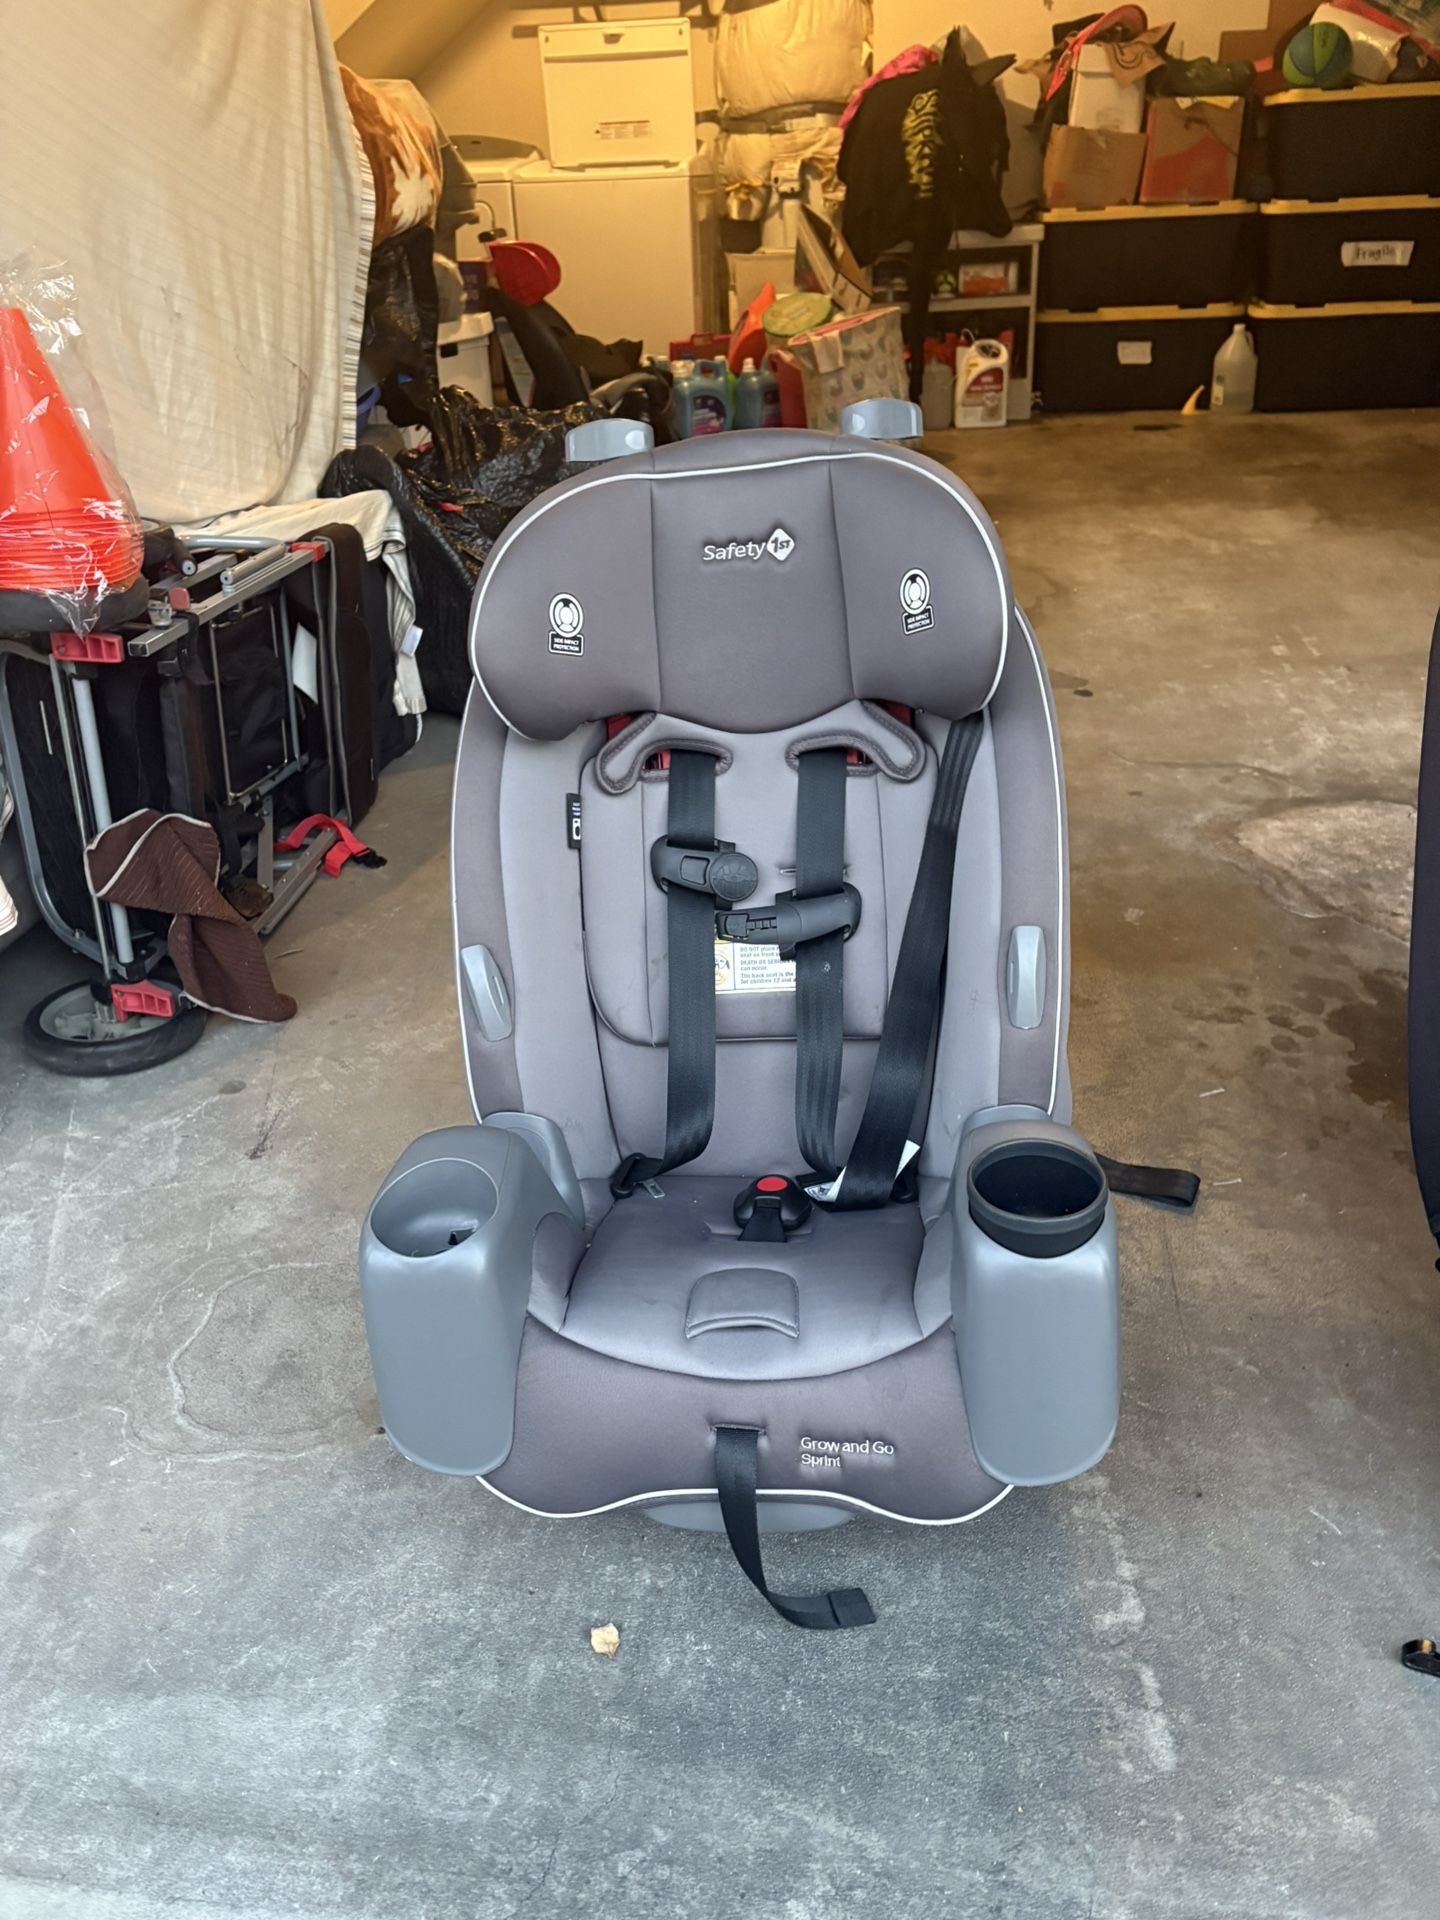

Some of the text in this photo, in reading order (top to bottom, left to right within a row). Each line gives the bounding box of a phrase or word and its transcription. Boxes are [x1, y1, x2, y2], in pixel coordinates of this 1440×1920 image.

[703, 541, 766, 561] Safety
[800, 1436, 895, 1455] Grow and Go
[801, 1453, 841, 1468] Sprint
